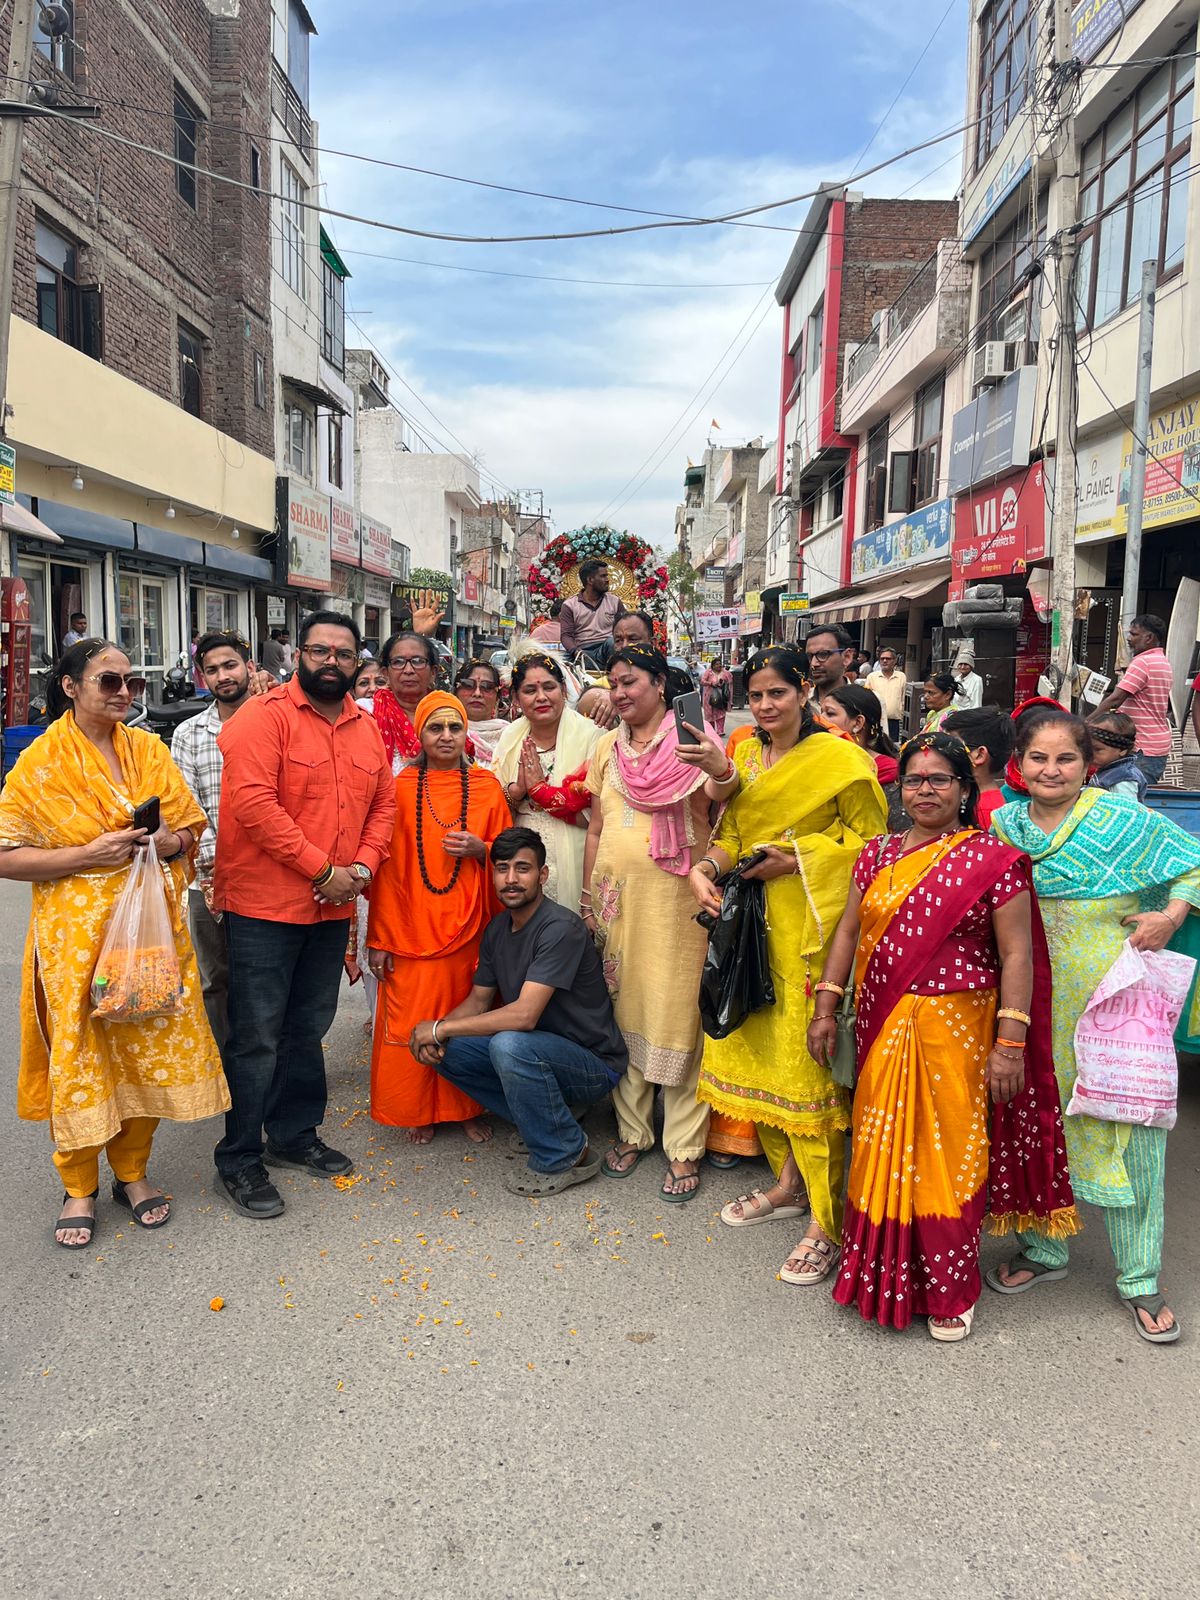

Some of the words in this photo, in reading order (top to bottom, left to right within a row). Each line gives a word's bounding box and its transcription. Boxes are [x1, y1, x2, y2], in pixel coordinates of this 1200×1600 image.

[1147, 400, 1199, 440] ANJAY
[953, 431, 980, 454] Crompton
[1086, 476, 1114, 501] PANEL
[290, 502, 328, 533] SHARMA
[333, 507, 354, 532] SHARMA
[369, 527, 390, 548] SHARMA
[395, 586, 449, 602] OPTIANS
[696, 610, 715, 618] SINGLA
